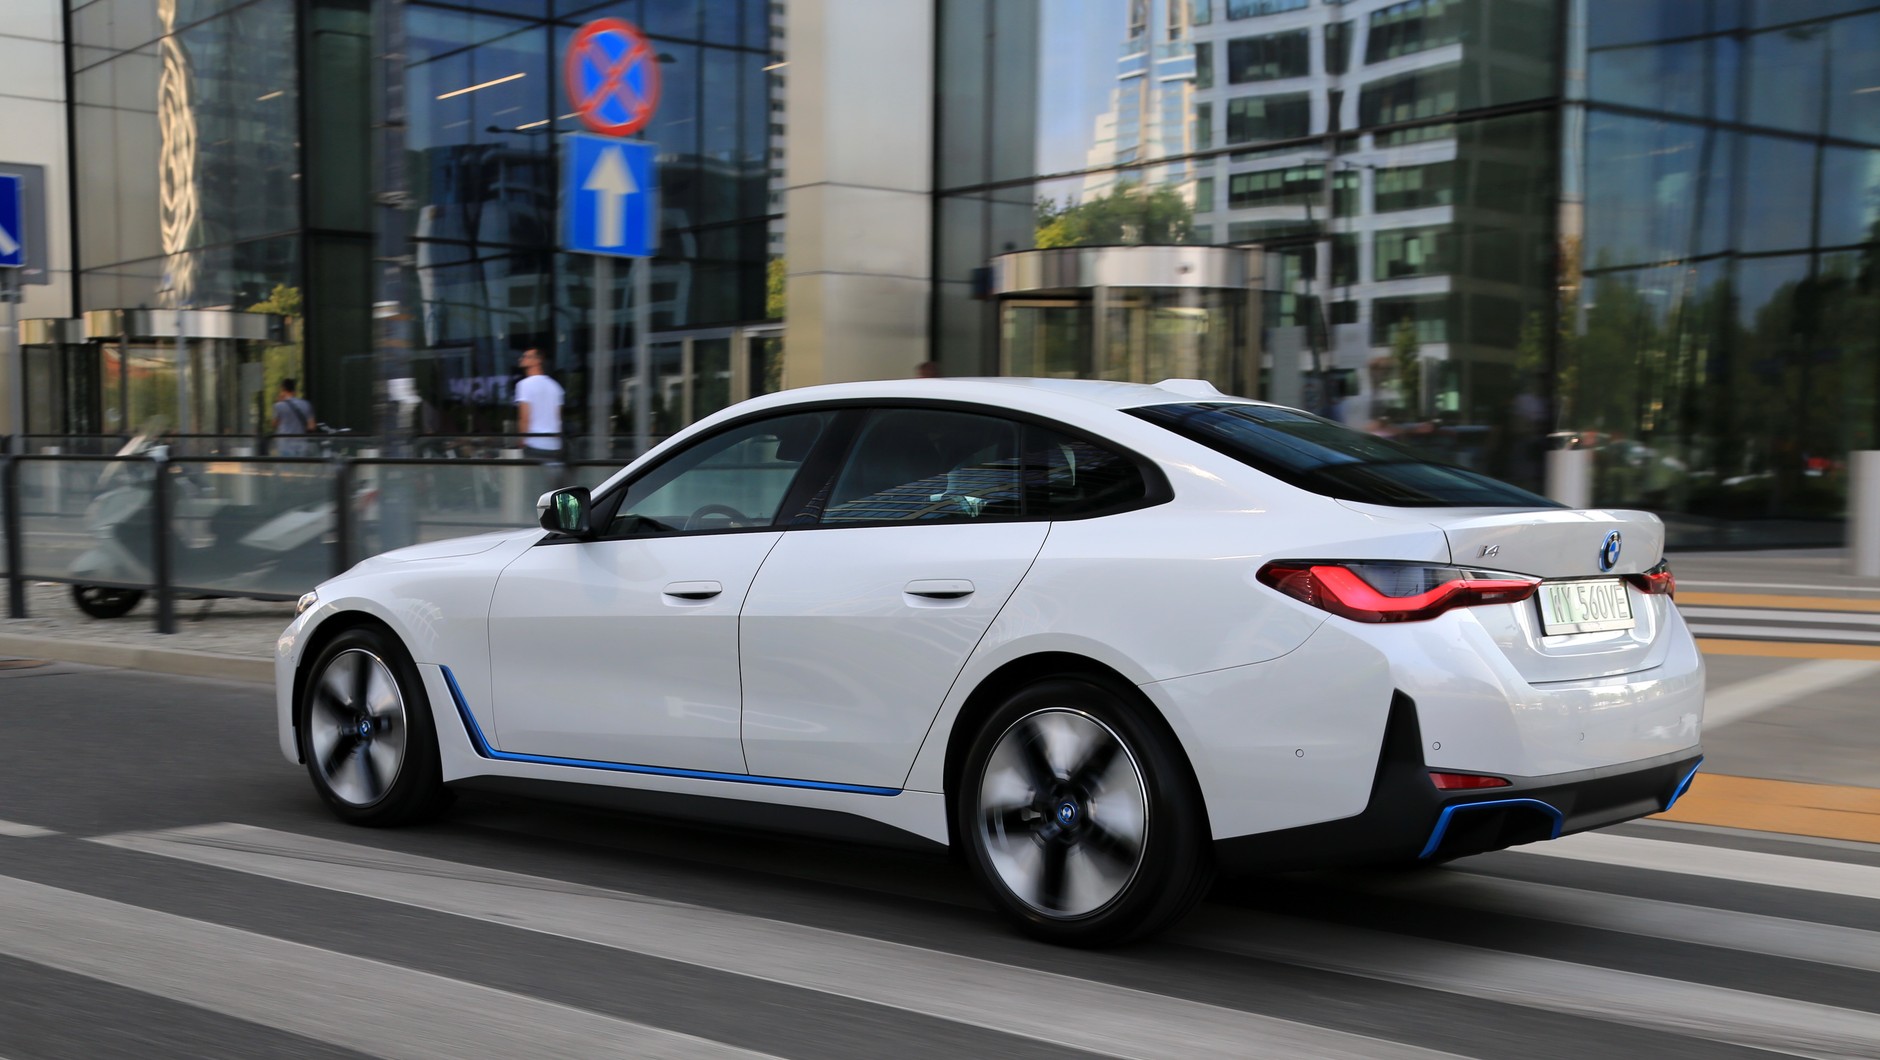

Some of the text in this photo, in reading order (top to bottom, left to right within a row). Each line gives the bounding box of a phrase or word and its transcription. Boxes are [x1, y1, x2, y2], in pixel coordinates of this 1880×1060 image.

[1476, 544, 1500, 559] i4
[1549, 584, 1628, 623] WY 560VE
